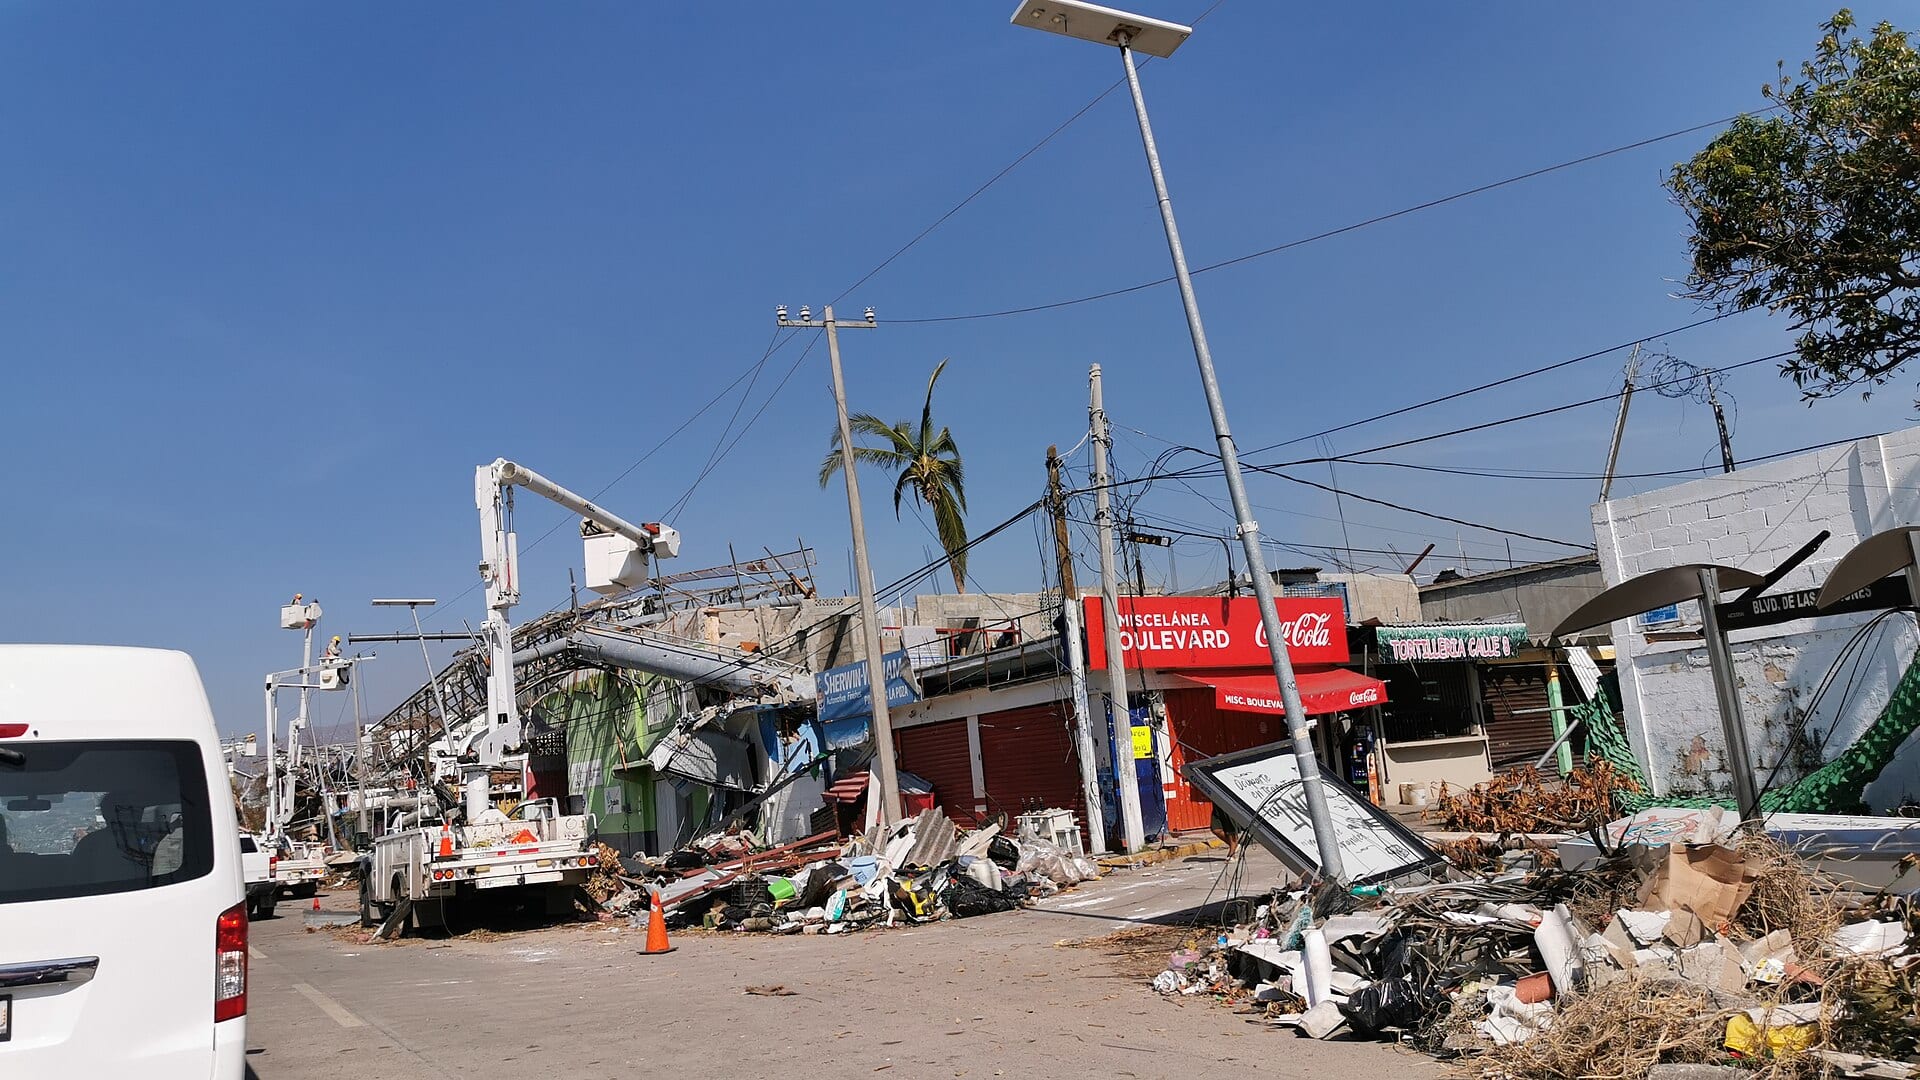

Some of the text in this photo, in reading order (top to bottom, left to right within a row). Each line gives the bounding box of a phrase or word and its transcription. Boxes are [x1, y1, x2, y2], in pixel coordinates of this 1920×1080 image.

[1752, 598, 1780, 615] BLVD.
[1782, 596, 1795, 609] DE
[1797, 591, 1816, 608] LAS
[1117, 611, 1210, 627] MISCELÁNEA
[1119, 629, 1230, 651] OULEVARD
[1257, 613, 1340, 651] Ca-Cola
[1390, 635, 1511, 660] TORTILLERIA CALLE 8
[1225, 694, 1284, 709] MISC. BOULEVA
